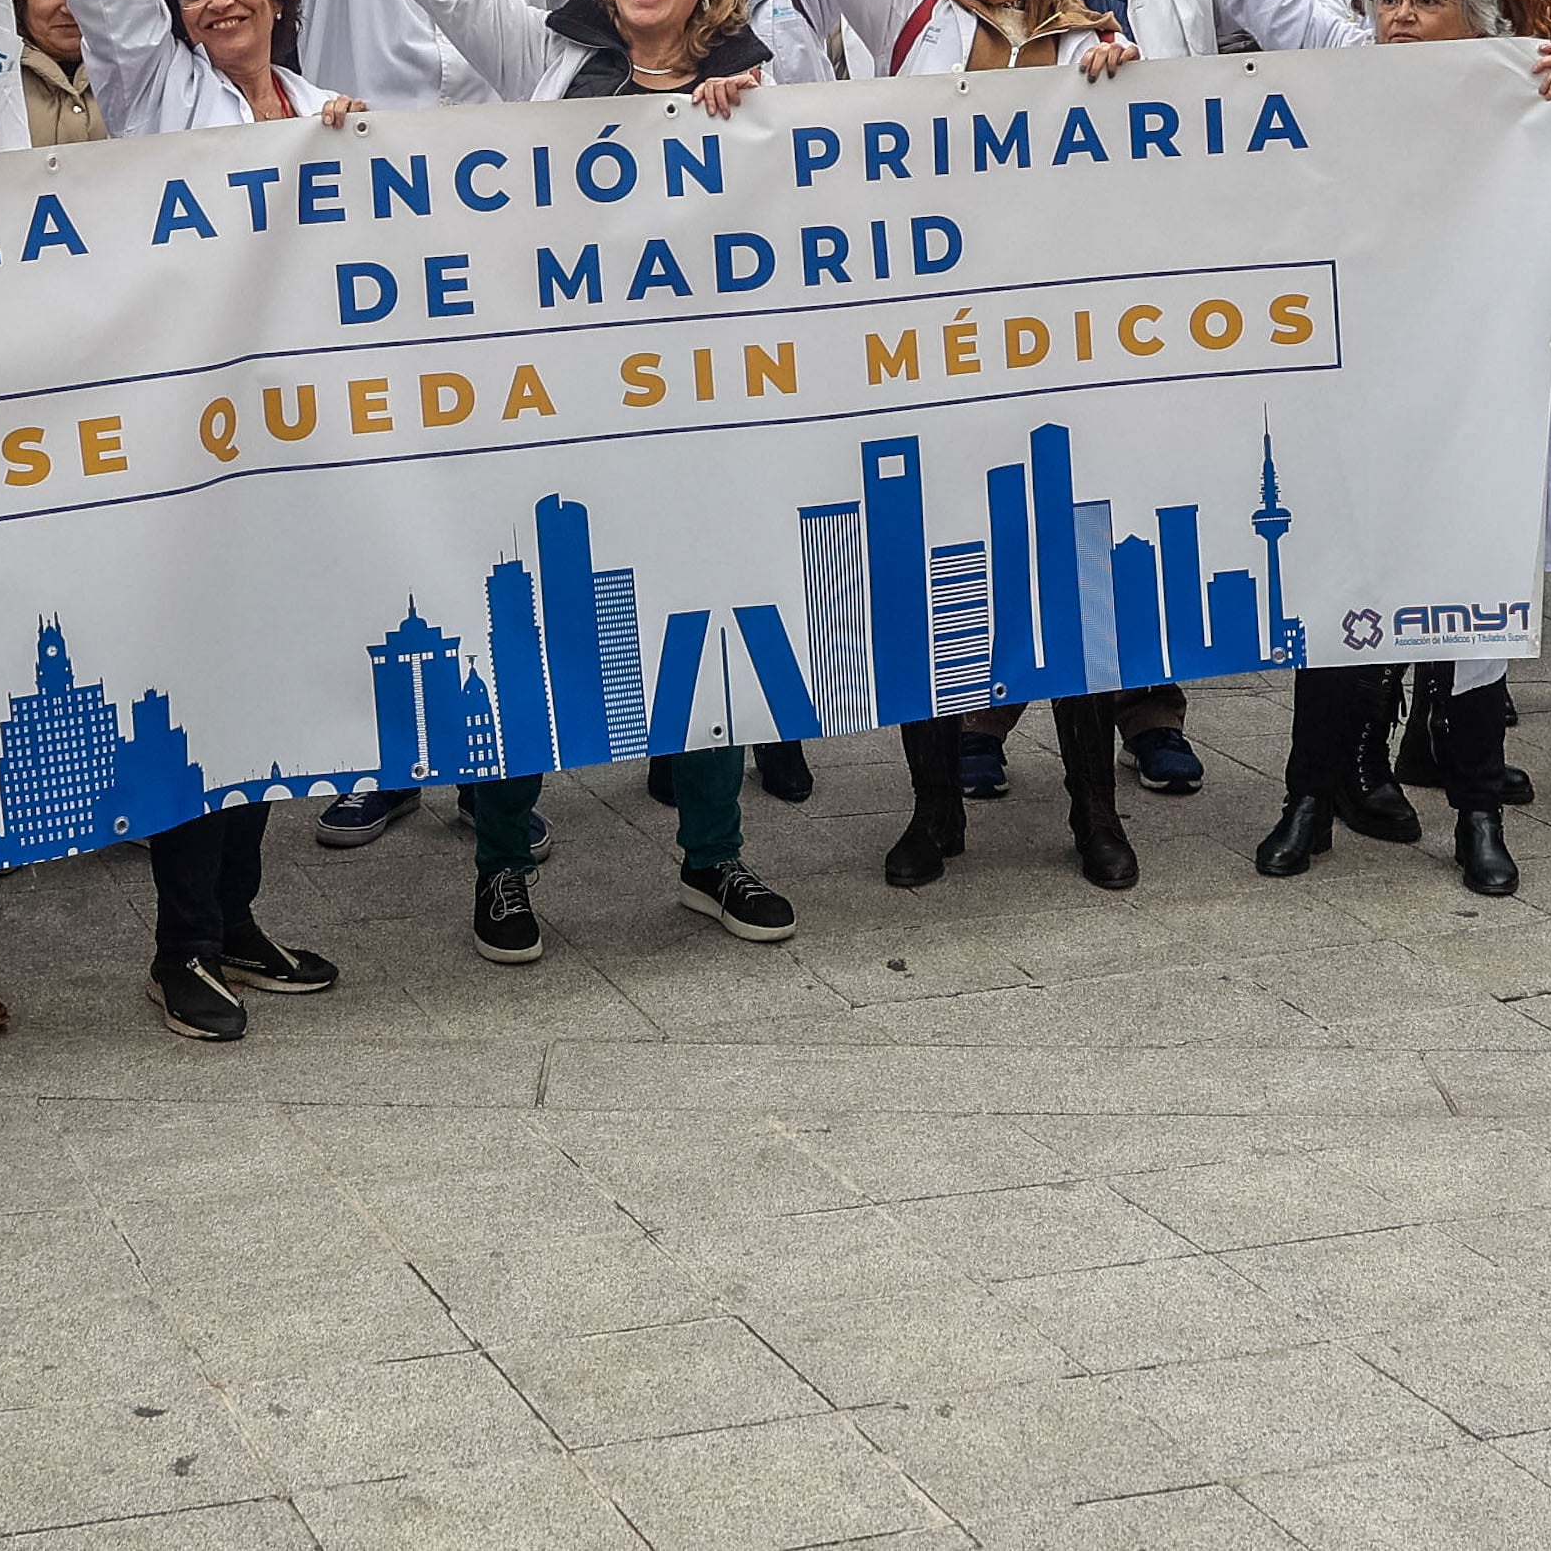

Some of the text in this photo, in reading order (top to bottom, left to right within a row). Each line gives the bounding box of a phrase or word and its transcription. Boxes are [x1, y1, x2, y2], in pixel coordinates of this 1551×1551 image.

[152, 124, 724, 246] ATENCIÓN
[793, 94, 1307, 187] PRIMARIA
[336, 215, 962, 325] DE MADRID
[1, 294, 1314, 486] SE QUEDA SIN MÉDICOS
